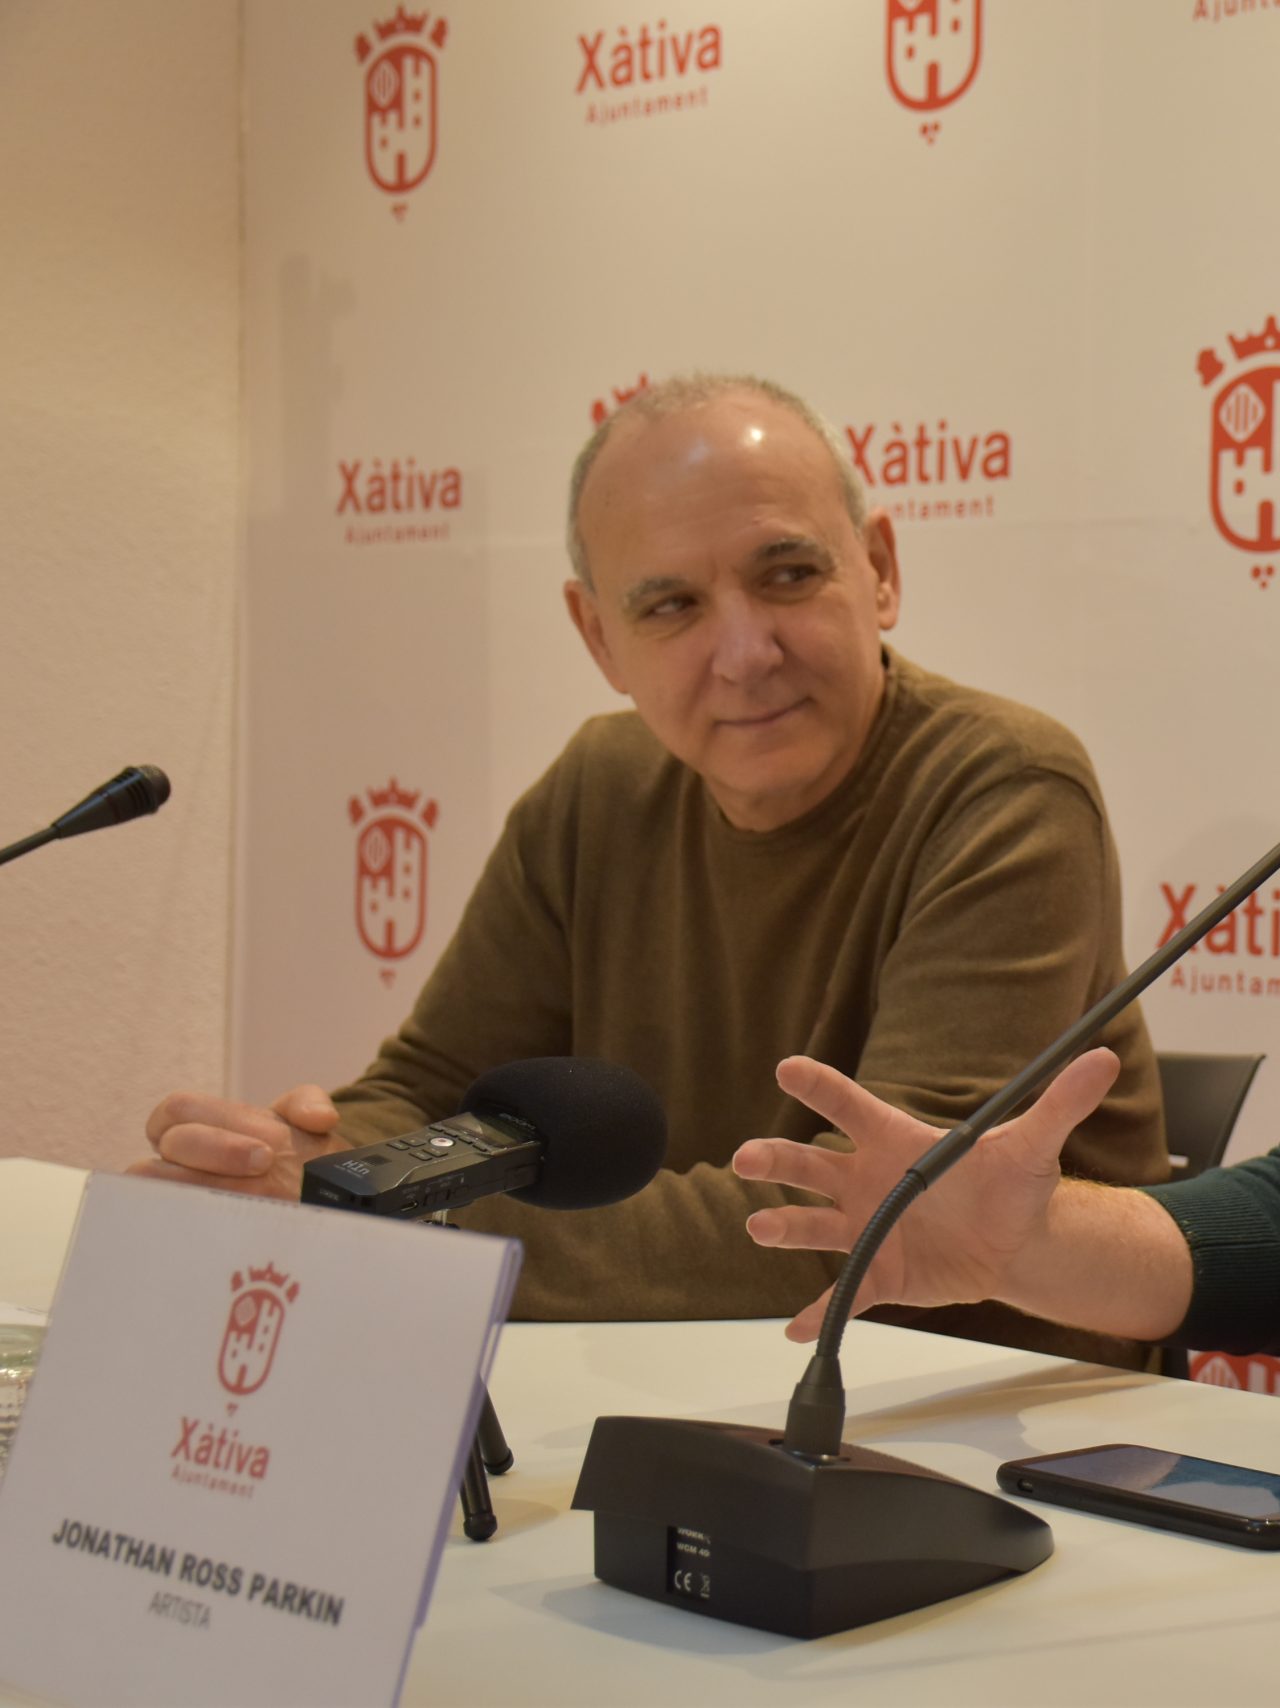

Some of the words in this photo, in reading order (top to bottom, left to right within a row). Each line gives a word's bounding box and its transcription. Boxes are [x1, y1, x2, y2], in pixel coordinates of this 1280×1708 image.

[575, 19, 722, 93] Xàtiva
[585, 87, 709, 126] Ajuntament
[846, 418, 1012, 488] Xàtiva
[337, 457, 462, 518] Xàtiva
[892, 494, 995, 520] ntament
[345, 522, 450, 546] Ajuntament
[170, 1416, 270, 1479] Xàtiva
[172, 1463, 254, 1499] Ajuntament
[52, 1517, 177, 1578] JONATHAN
[179, 1551, 243, 1597] ROSS
[248, 1573, 346, 1628] PARKIN
[147, 1590, 212, 1630] ARTISTA
